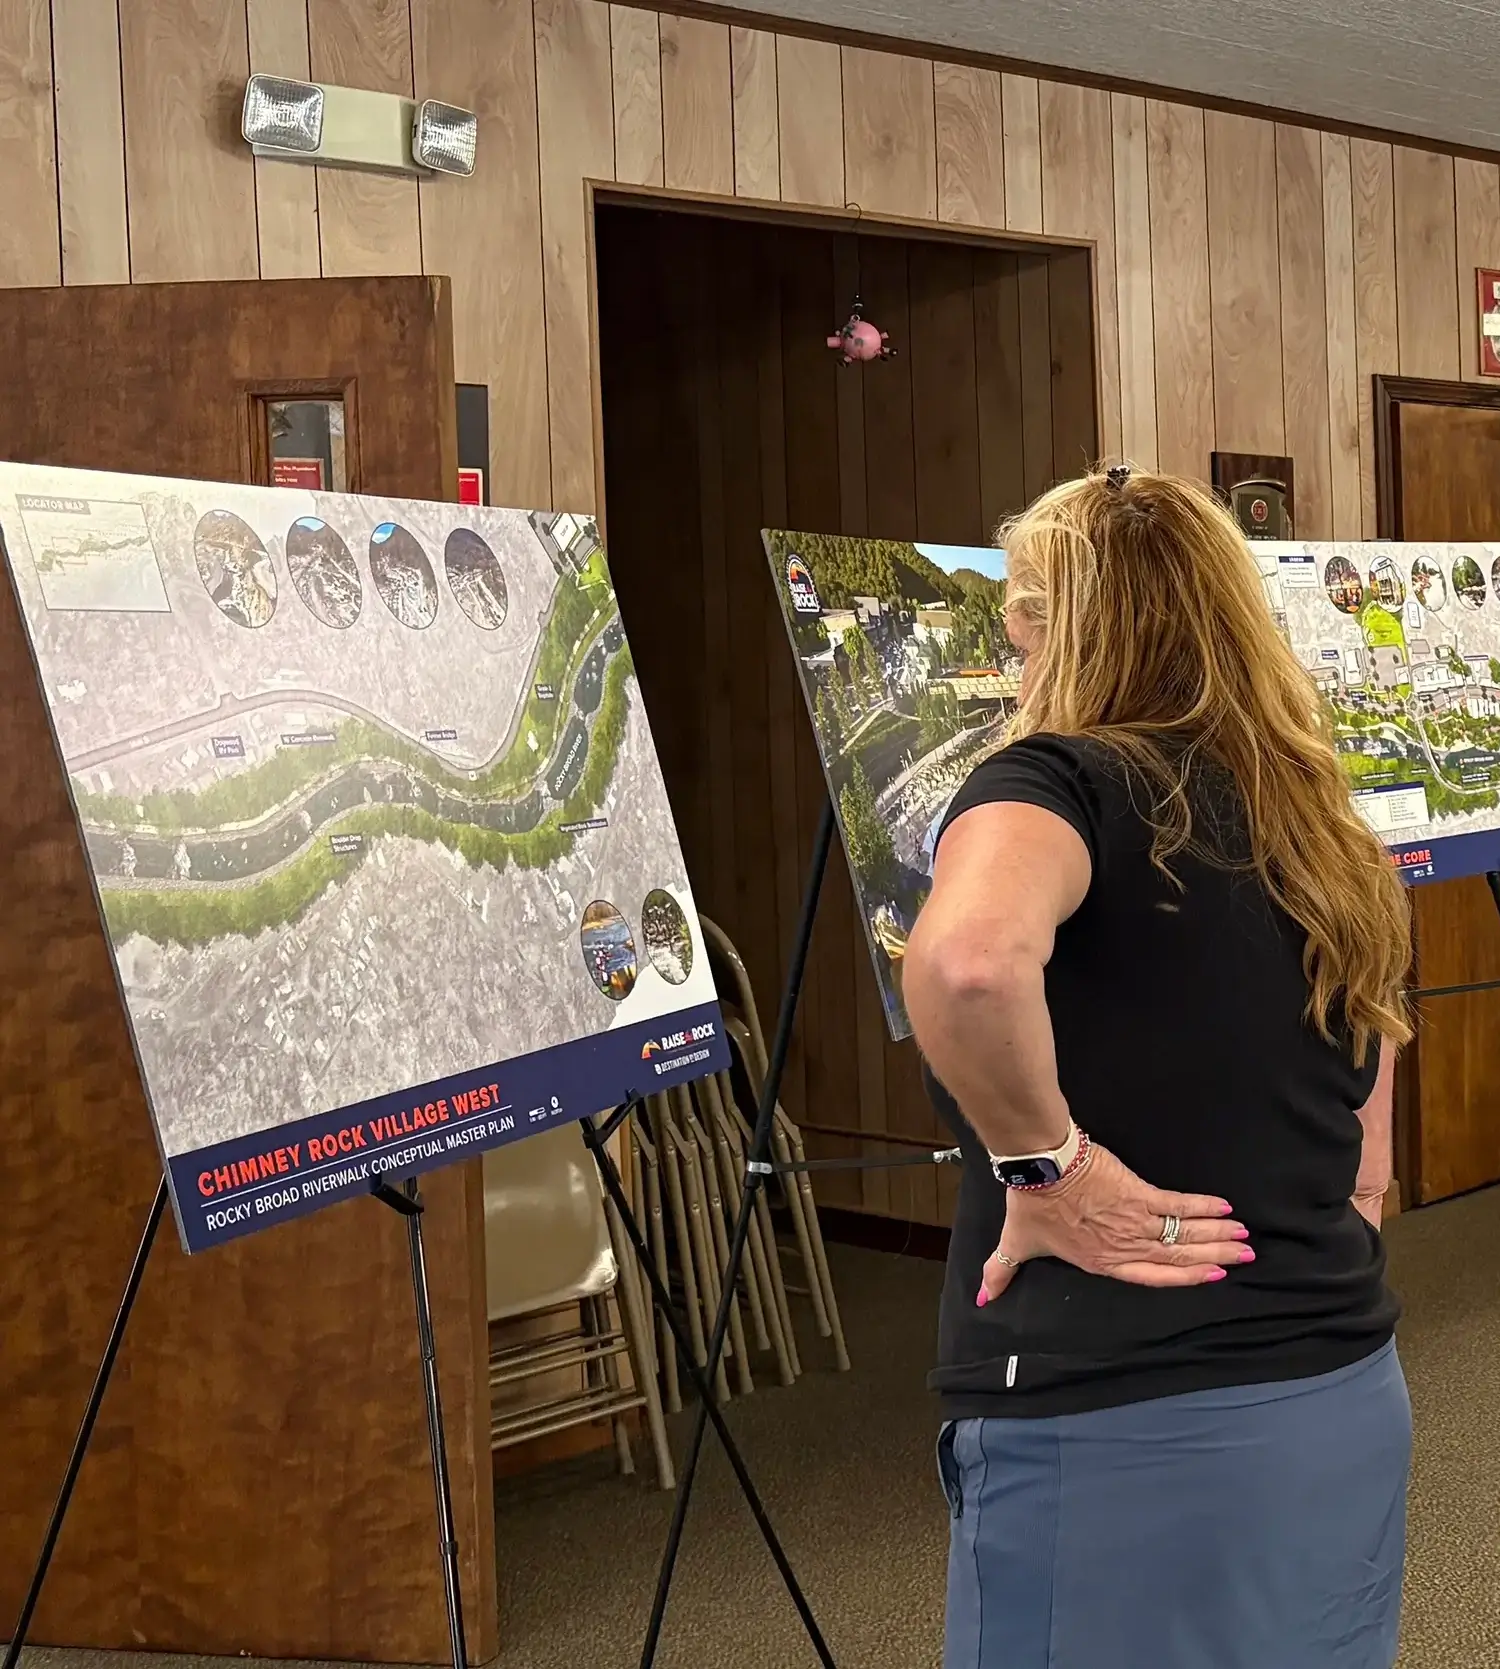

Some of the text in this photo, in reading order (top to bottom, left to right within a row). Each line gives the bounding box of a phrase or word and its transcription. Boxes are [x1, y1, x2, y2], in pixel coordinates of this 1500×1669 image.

[22, 497, 85, 511] LOCATOR MAP
[1403, 849, 1432, 864] CORE
[661, 1031, 687, 1050] RAISE
[691, 1022, 716, 1041] ROCK
[197, 1143, 301, 1198] CHIMNEY
[307, 1124, 368, 1163] ROCK
[369, 1102, 450, 1142] VILLAGE
[451, 1083, 501, 1116] WEST
[206, 1115, 516, 1232] ROCKY BROAD RIVERWALK CONCEPTUAL MASTER PLAN
